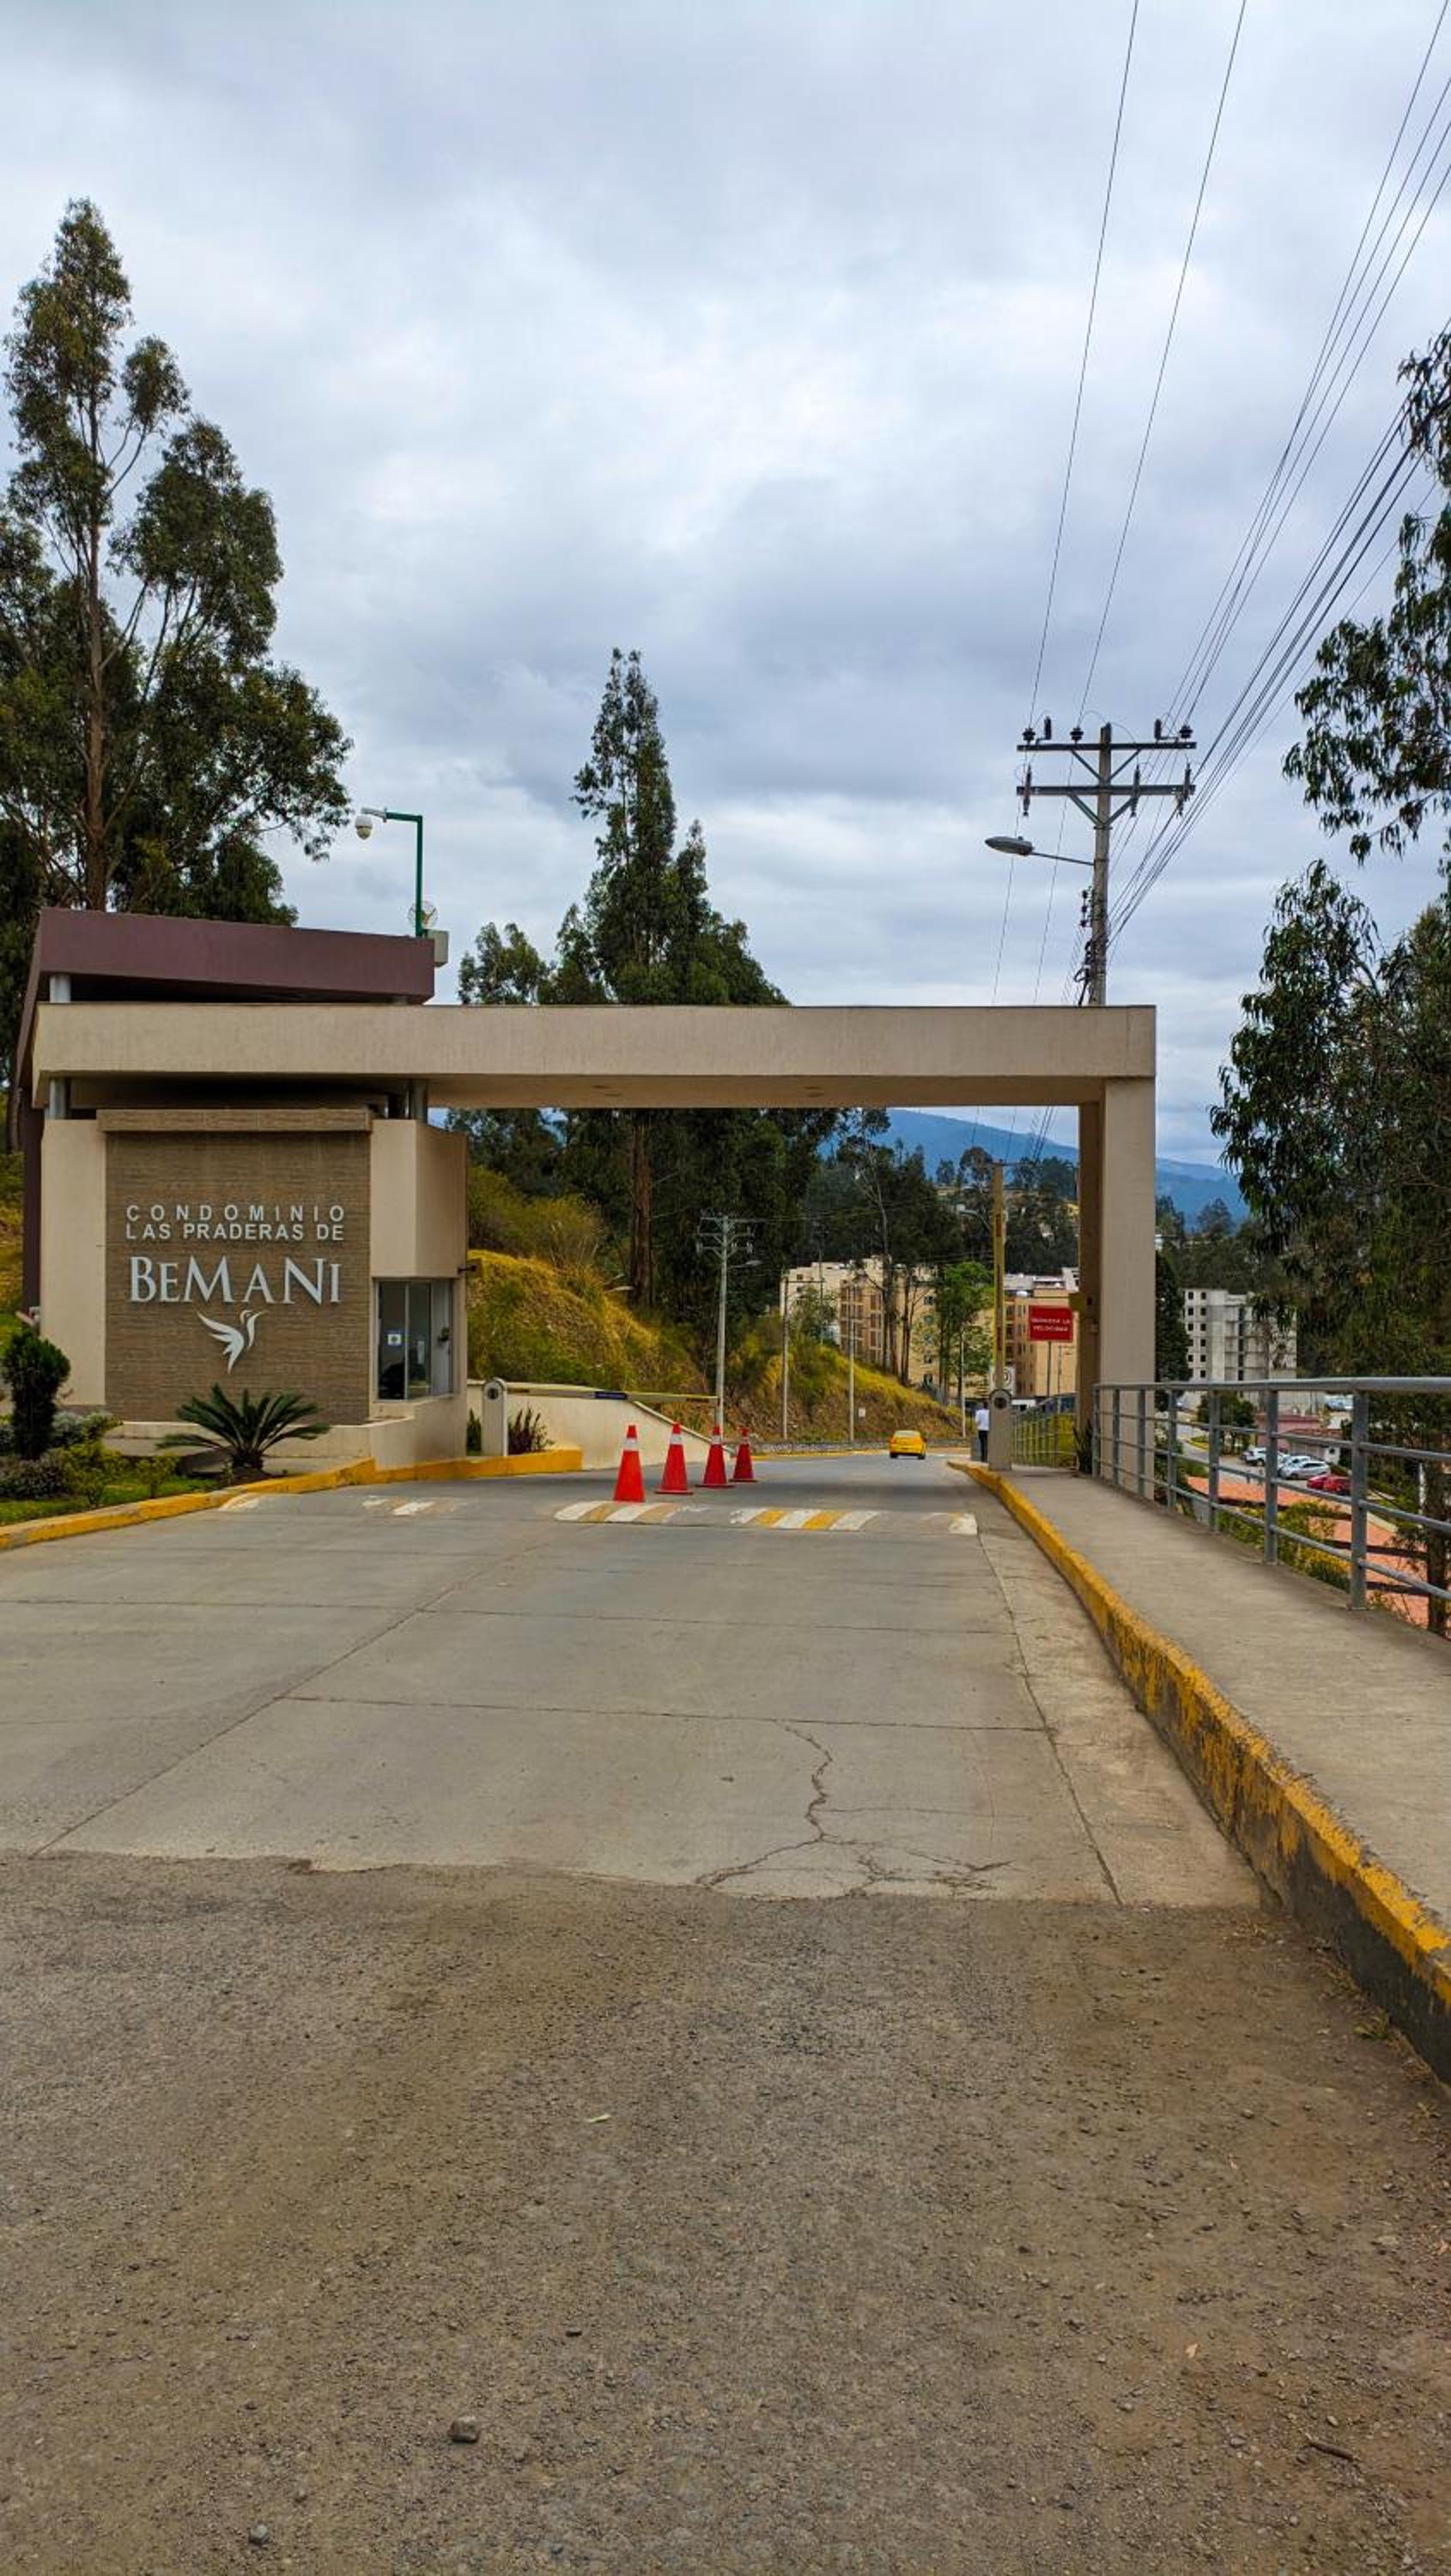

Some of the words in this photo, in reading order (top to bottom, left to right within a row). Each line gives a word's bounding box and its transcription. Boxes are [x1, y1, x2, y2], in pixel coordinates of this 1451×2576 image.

[126, 1205, 344, 1222] CONDOMINIO
[126, 1224, 171, 1240] LAS
[183, 1224, 304, 1241] PRADERAS
[317, 1224, 344, 1241] DE
